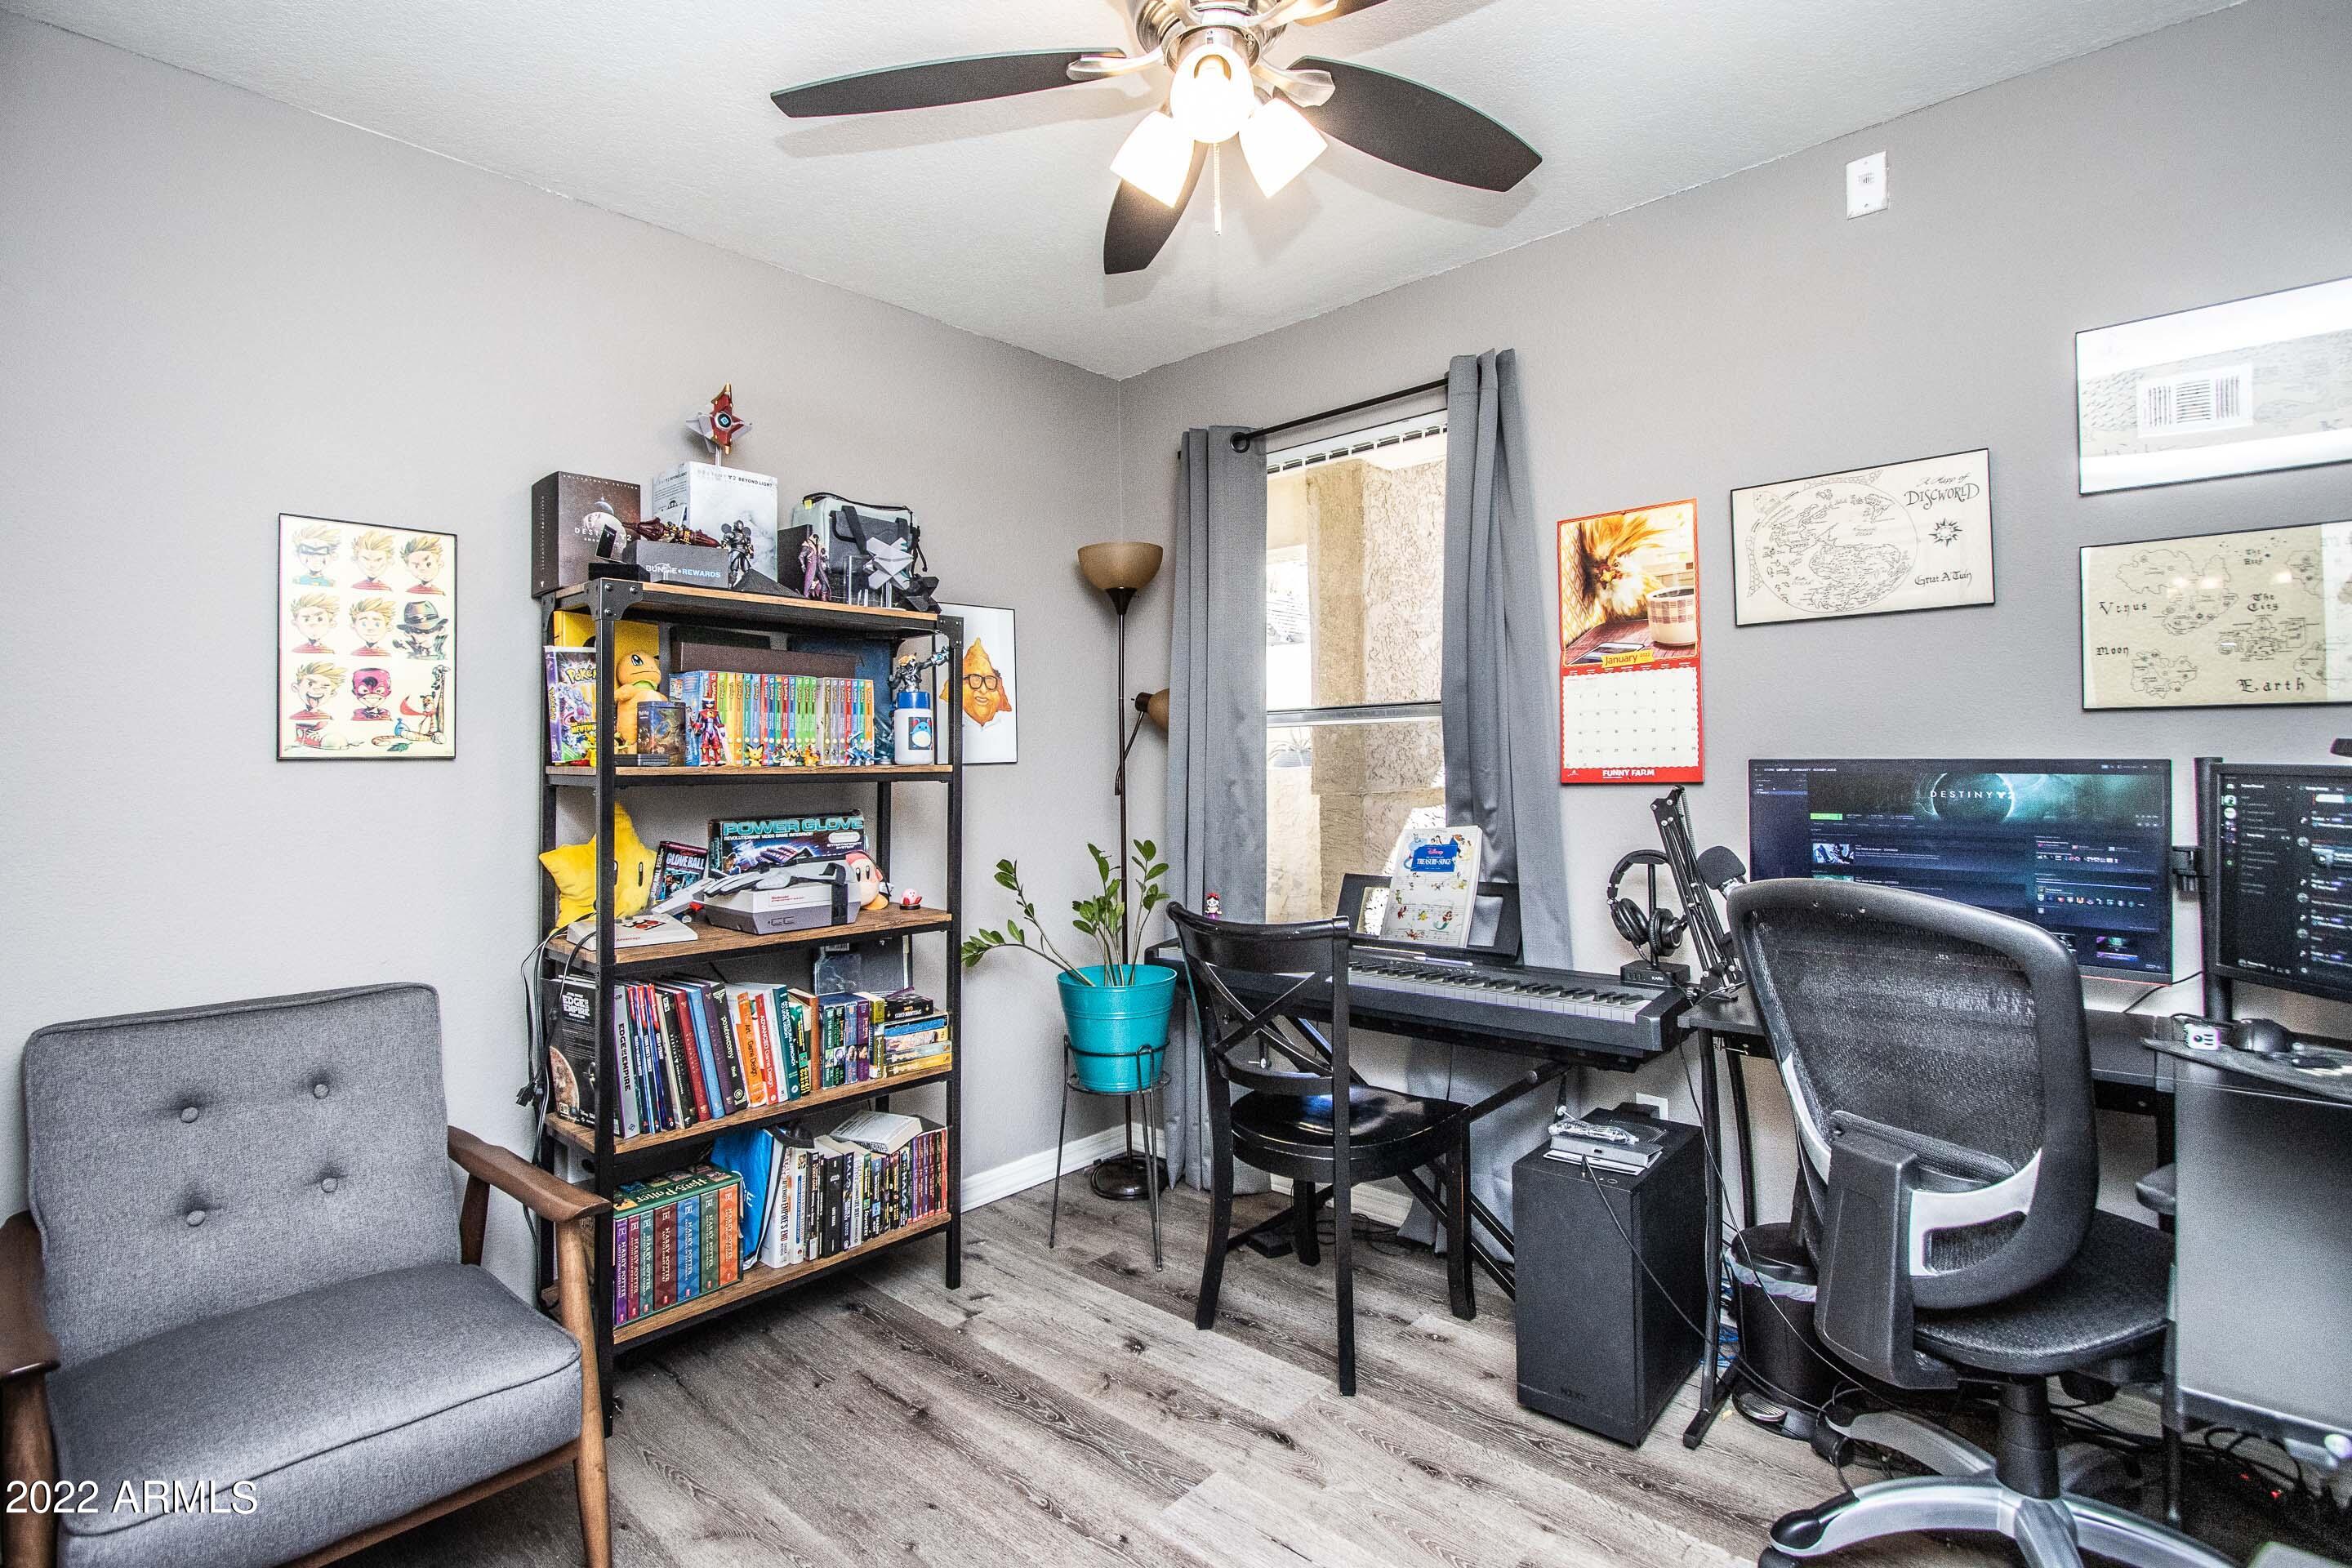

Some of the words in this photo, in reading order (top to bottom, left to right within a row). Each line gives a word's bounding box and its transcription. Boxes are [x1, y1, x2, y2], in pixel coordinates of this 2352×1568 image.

[737, 476, 759, 485] BEYOND
[759, 480, 773, 488] LIGHT
[1904, 483, 1980, 510] DISCWORLD
[682, 568, 720, 578] REWARDS
[2099, 601, 2148, 618] Venus
[1605, 653, 1637, 666] January
[2096, 646, 2130, 659] Moon
[2236, 678, 2306, 693] Earth
[1601, 768, 1630, 777] FUNNY
[1631, 768, 1655, 777] FARM
[1930, 791, 1993, 800] DESTINY
[724, 820, 800, 836] POWER
[802, 817, 864, 832] GLOVE
[724, 833, 760, 841] REVOLUTIONARY
[562, 994, 585, 1008] EDGE
[563, 1004, 590, 1017] EMPIRE
[618, 1022, 626, 1049] EDGE
[760, 1015, 769, 1049] ADVANCED
[750, 1057, 758, 1076] Design
[621, 1056, 632, 1092] EMPIRE
[844, 1155, 853, 1189] HALO
[675, 1178, 708, 1192] Harry
[637, 1187, 679, 1202] Potter
[780, 1202, 789, 1230] EMPIRE'S
[780, 1229, 789, 1242] END
